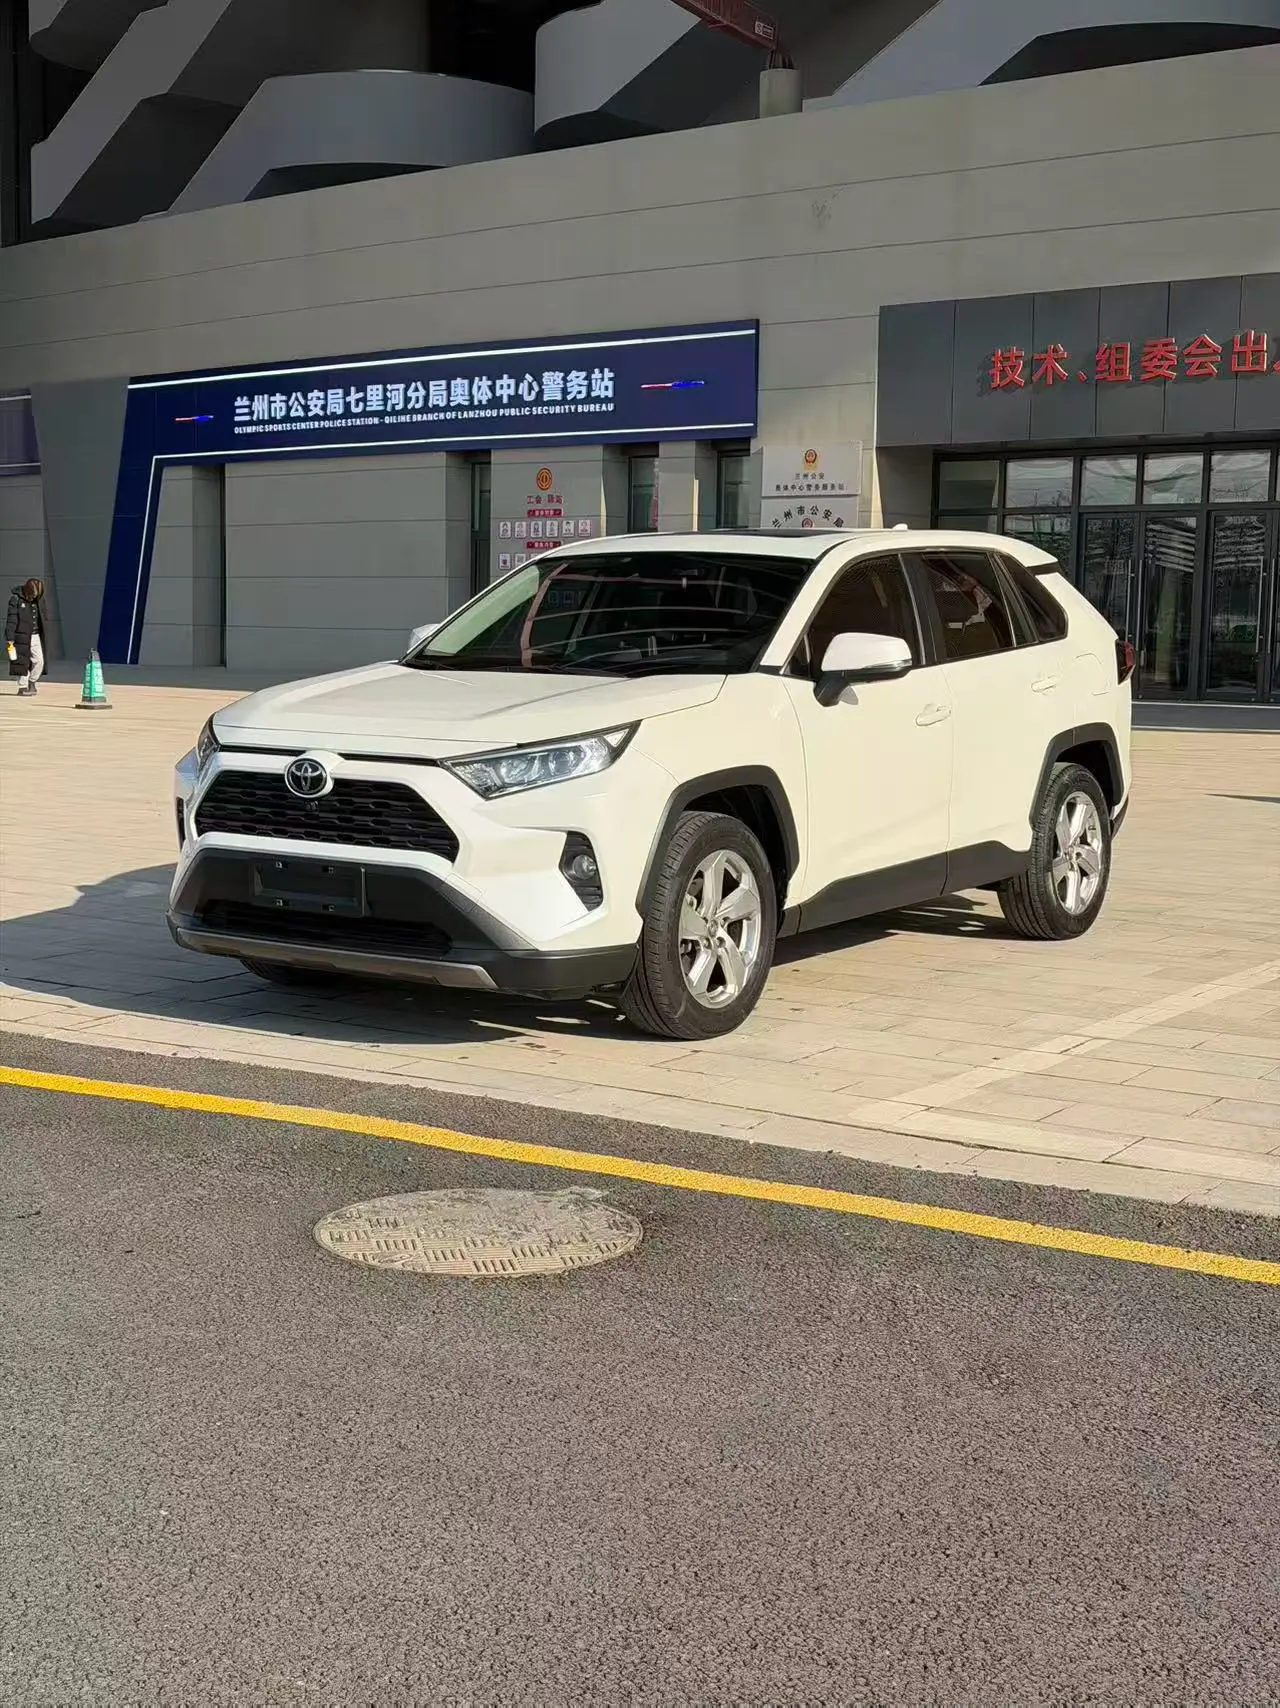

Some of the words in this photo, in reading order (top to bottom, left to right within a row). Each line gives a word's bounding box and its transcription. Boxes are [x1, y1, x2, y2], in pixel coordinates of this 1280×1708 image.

[989, 330, 1280, 389] 技术、组委会出
[234, 368, 615, 422] 兰州市公安局七里河分局奥体中心警务站
[234, 425, 264, 434] OLYMPIC
[264, 423, 291, 432] SPORTS
[292, 421, 319, 430] CENTER
[320, 419, 346, 428] POLICE
[347, 417, 379, 427] STATION
[384, 415, 412, 424] QILIHE
[412, 411, 445, 422] BRANCH
[445, 411, 457, 420] OF
[457, 408, 498, 419] LANZHOU
[499, 406, 532, 417] PUBLIC
[532, 404, 576, 415] SECURITY
[577, 402, 615, 413] BUREAU
